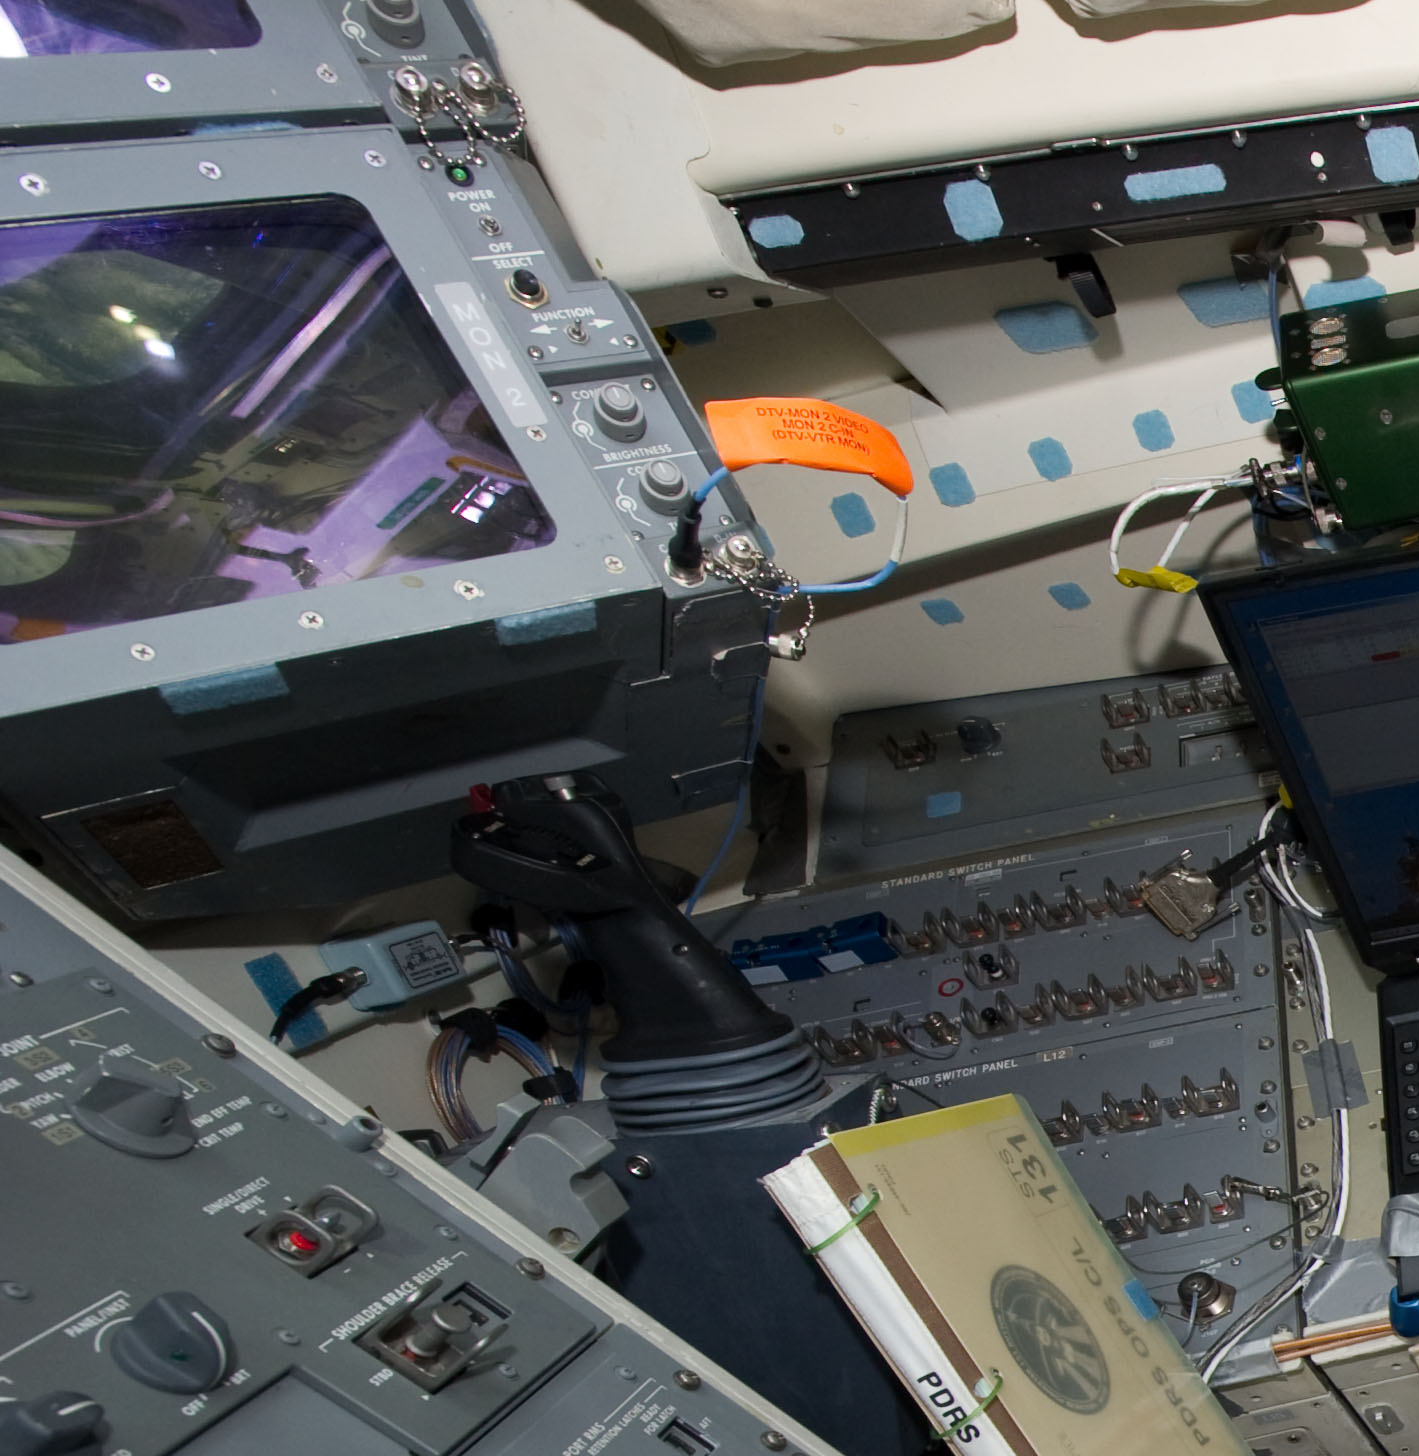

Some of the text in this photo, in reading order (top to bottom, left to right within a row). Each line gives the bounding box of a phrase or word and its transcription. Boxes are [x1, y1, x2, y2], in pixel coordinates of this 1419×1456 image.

[448, 189, 496, 202] POWER
[469, 202, 491, 213] ON
[489, 242, 514, 254] OFF
[492, 257, 534, 270] SELECT
[532, 306, 595, 323] FUNCTION
[756, 406, 869, 434] DTV-MON 2 VIDEO
[782, 417, 816, 430] MON
[817, 420, 827, 430] 2
[602, 443, 673, 464] BRIGHTNESS
[771, 429, 871, 456] (DTV-VTR MON)
[881, 854, 1035, 890] STANDARD SWITCH PANEL
[1043, 1050, 1067, 1062] L12
[935, 1059, 1019, 1083] SWITCH PANEL
[191, 1095, 253, 1128] END EFF TEMP
[219, 1121, 246, 1138] TEMP
[998, 1149, 1036, 1200] STS
[1006, 1133, 1060, 1204] 131
[202, 1176, 272, 1216] SINGLE/DIRECT
[234, 1194, 267, 1215] DRIVE
[332, 1256, 455, 1341] SHOULDER BRACE RELEASE
[64, 1298, 133, 1339] PANEL/INST
[1070, 1236, 1211, 1448] PDRS OPS C/L
[369, 1368, 395, 1387] STBD
[181, 1400, 206, 1417] OFF
[639, 1402, 661, 1423] READY
[916, 1371, 982, 1444] PDRS
[587, 1401, 646, 1456] RETENTION LATCHES
[644, 1404, 678, 1436] FOR LATCH
[699, 1416, 712, 1430] AFT
[582, 1421, 607, 1443] RMS
